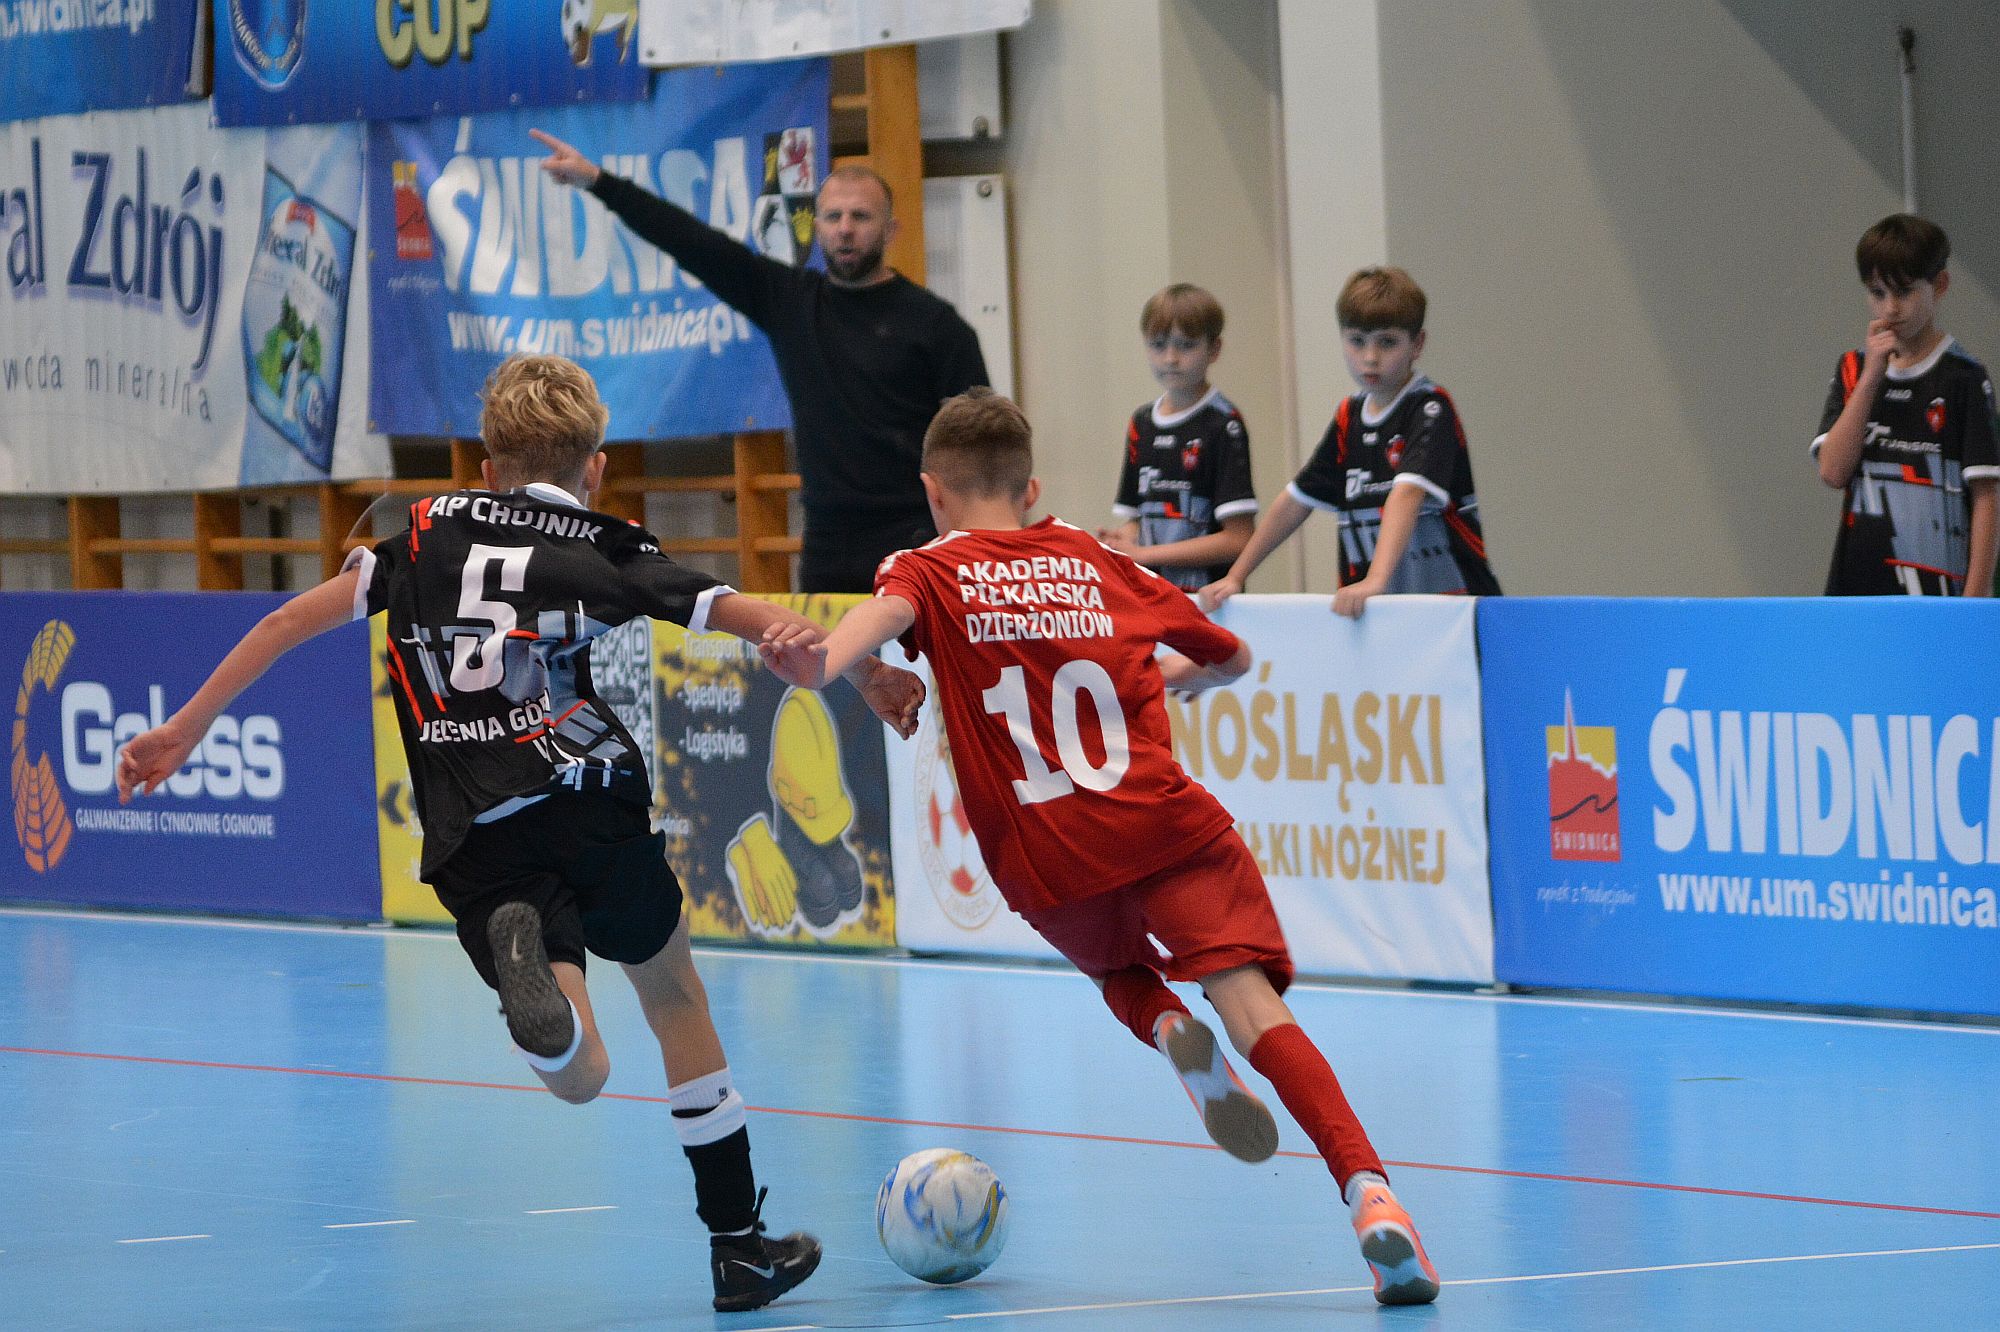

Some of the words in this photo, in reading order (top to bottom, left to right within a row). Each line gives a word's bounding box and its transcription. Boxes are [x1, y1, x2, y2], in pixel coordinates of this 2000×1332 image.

[376, 0, 488, 66] CUP
[0, 137, 44, 286] al
[66, 146, 225, 380] Zdrój
[4, 348, 62, 391] woda
[85, 350, 211, 422] mineralna
[426, 495, 469, 518] AP
[471, 497, 603, 544] CHOJNIK
[957, 556, 1101, 583] AKADEMIA
[960, 582, 1105, 610] PIŁKARSKA
[449, 543, 534, 693] 5
[965, 605, 1114, 643] DZIERŻONIÓW
[418, 717, 505, 742] JELENIA
[982, 659, 1131, 805] 10
[160, 811, 220, 834] CYNKOWNIE
[222, 813, 274, 836] OGNIOWE
[1309, 807, 1447, 885] NOŻNEJ
